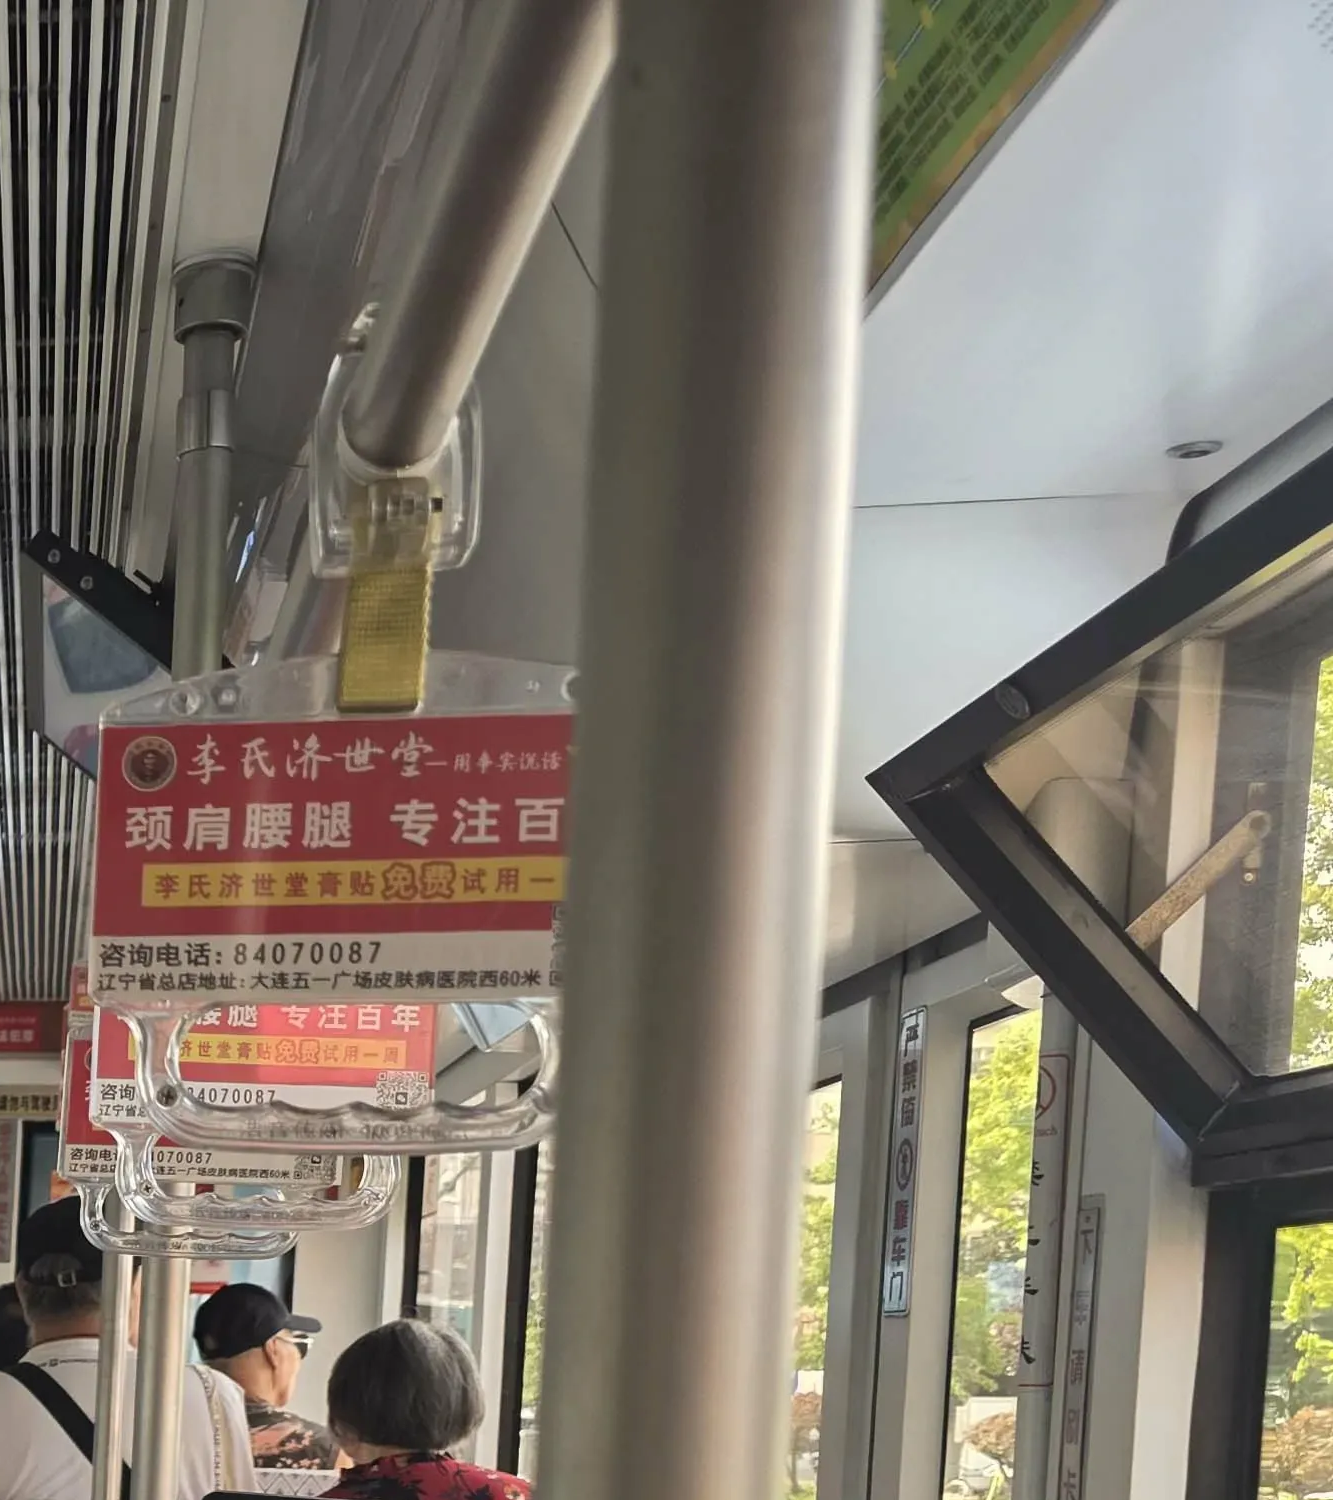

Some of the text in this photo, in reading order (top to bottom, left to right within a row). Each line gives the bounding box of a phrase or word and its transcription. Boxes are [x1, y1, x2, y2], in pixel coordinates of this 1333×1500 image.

[187, 731, 434, 785] 李氏济世堂
[124, 798, 565, 852] 颈肩腰腿 专注百
[155, 863, 555, 900] 李氏济世堂膏贴免费试用一
[281, 1004, 420, 1032] 专注百年
[180, 1039, 399, 1064] 济世堂膏贴免费试用一周
